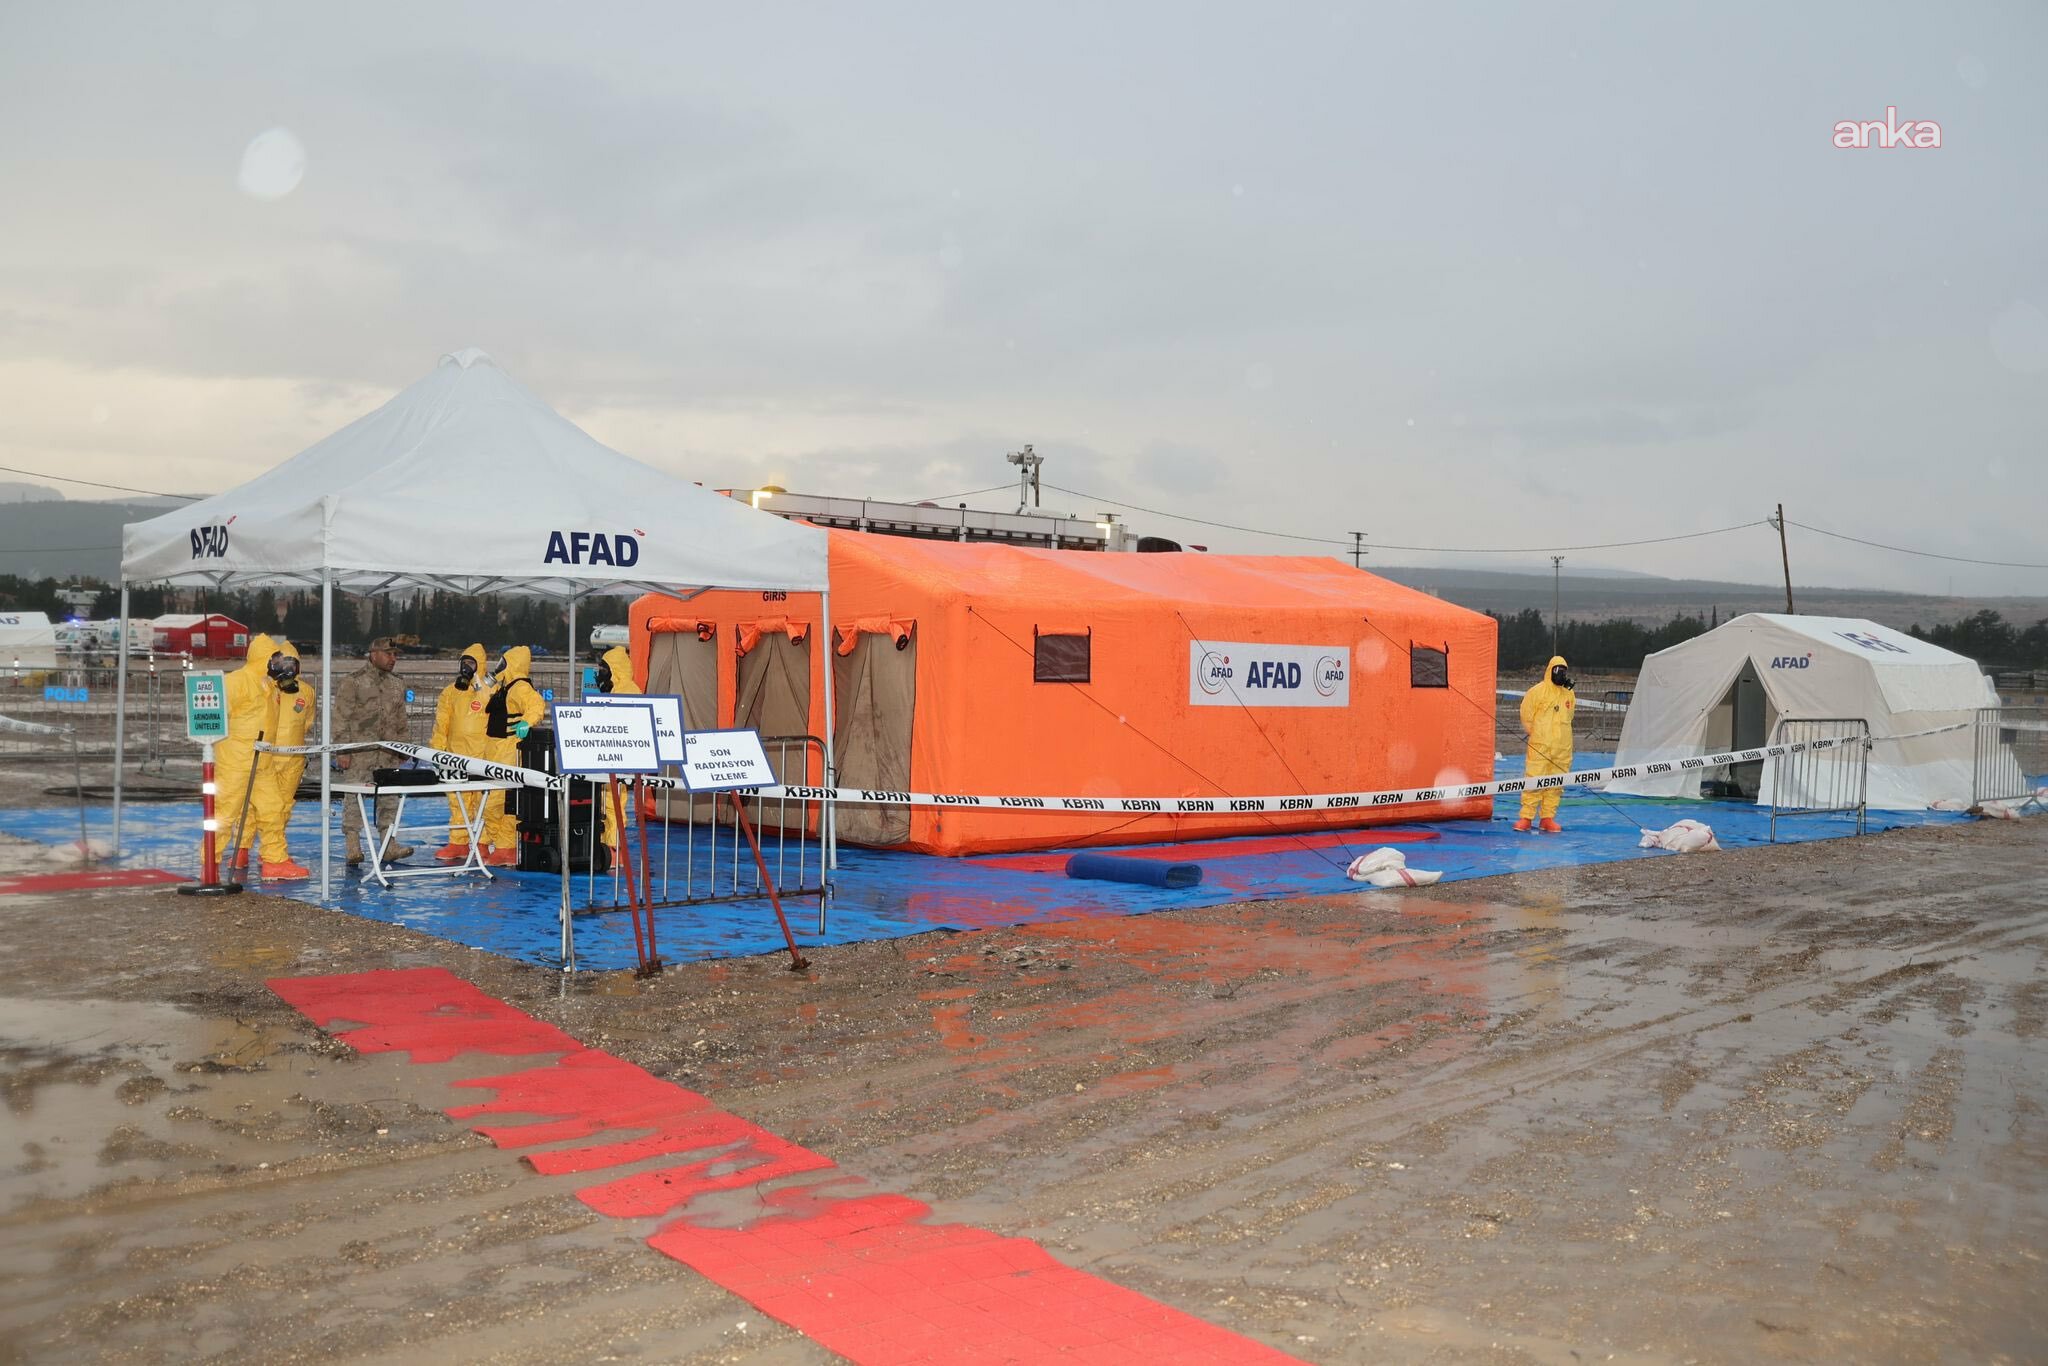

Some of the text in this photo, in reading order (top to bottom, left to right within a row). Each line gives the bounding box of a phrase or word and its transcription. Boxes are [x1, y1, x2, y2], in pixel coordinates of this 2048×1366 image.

[190, 525, 229, 560] AFAD
[544, 530, 639, 568] AFAD
[1771, 656, 1810, 669] AFAD
[1211, 661, 1344, 689] AFAD AFAD AFAD
[559, 710, 582, 719] AFAD
[583, 725, 629, 734] KAZAZEDE
[564, 738, 651, 748] DEKONTAMİNASYON
[597, 754, 623, 762] ALANI
[710, 749, 731, 757] SON
[694, 760, 755, 770] RADYASYON
[432, 752, 470, 771] KBRN
[485, 764, 525, 784] KBRN
[785, 786, 838, 799] KBRN
[861, 790, 911, 802] KBRN
[933, 794, 980, 805] KBRN
[999, 798, 1045, 808] KBRN
[1062, 799, 1105, 810] KBRN
[1122, 799, 1161, 811] KBRN
[1178, 800, 1214, 811] KBRN
[1230, 800, 1265, 811] KBRN
[1280, 798, 1313, 809] KBRN
[1327, 796, 1359, 808] KBRN
[1372, 793, 1403, 805] KBRN
[1416, 790, 1445, 801] KBRN
[1458, 786, 1486, 797] KBRN
[1498, 781, 1525, 792] KBRN
[1537, 776, 1564, 788] KBRN
[1575, 772, 1601, 783] KBRN
[1611, 767, 1637, 778] KBRN
[1647, 763, 1672, 774] KBRN
[1680, 758, 1704, 769] KBRN
[1712, 754, 1734, 764] KBRN
[1741, 750, 1762, 760] KBRN
[1767, 747, 1785, 757] KBRN
[1791, 744, 1806, 753] KBRN
[1812, 740, 1834, 749] KBRN
[711, 772, 749, 781] İZLEME
